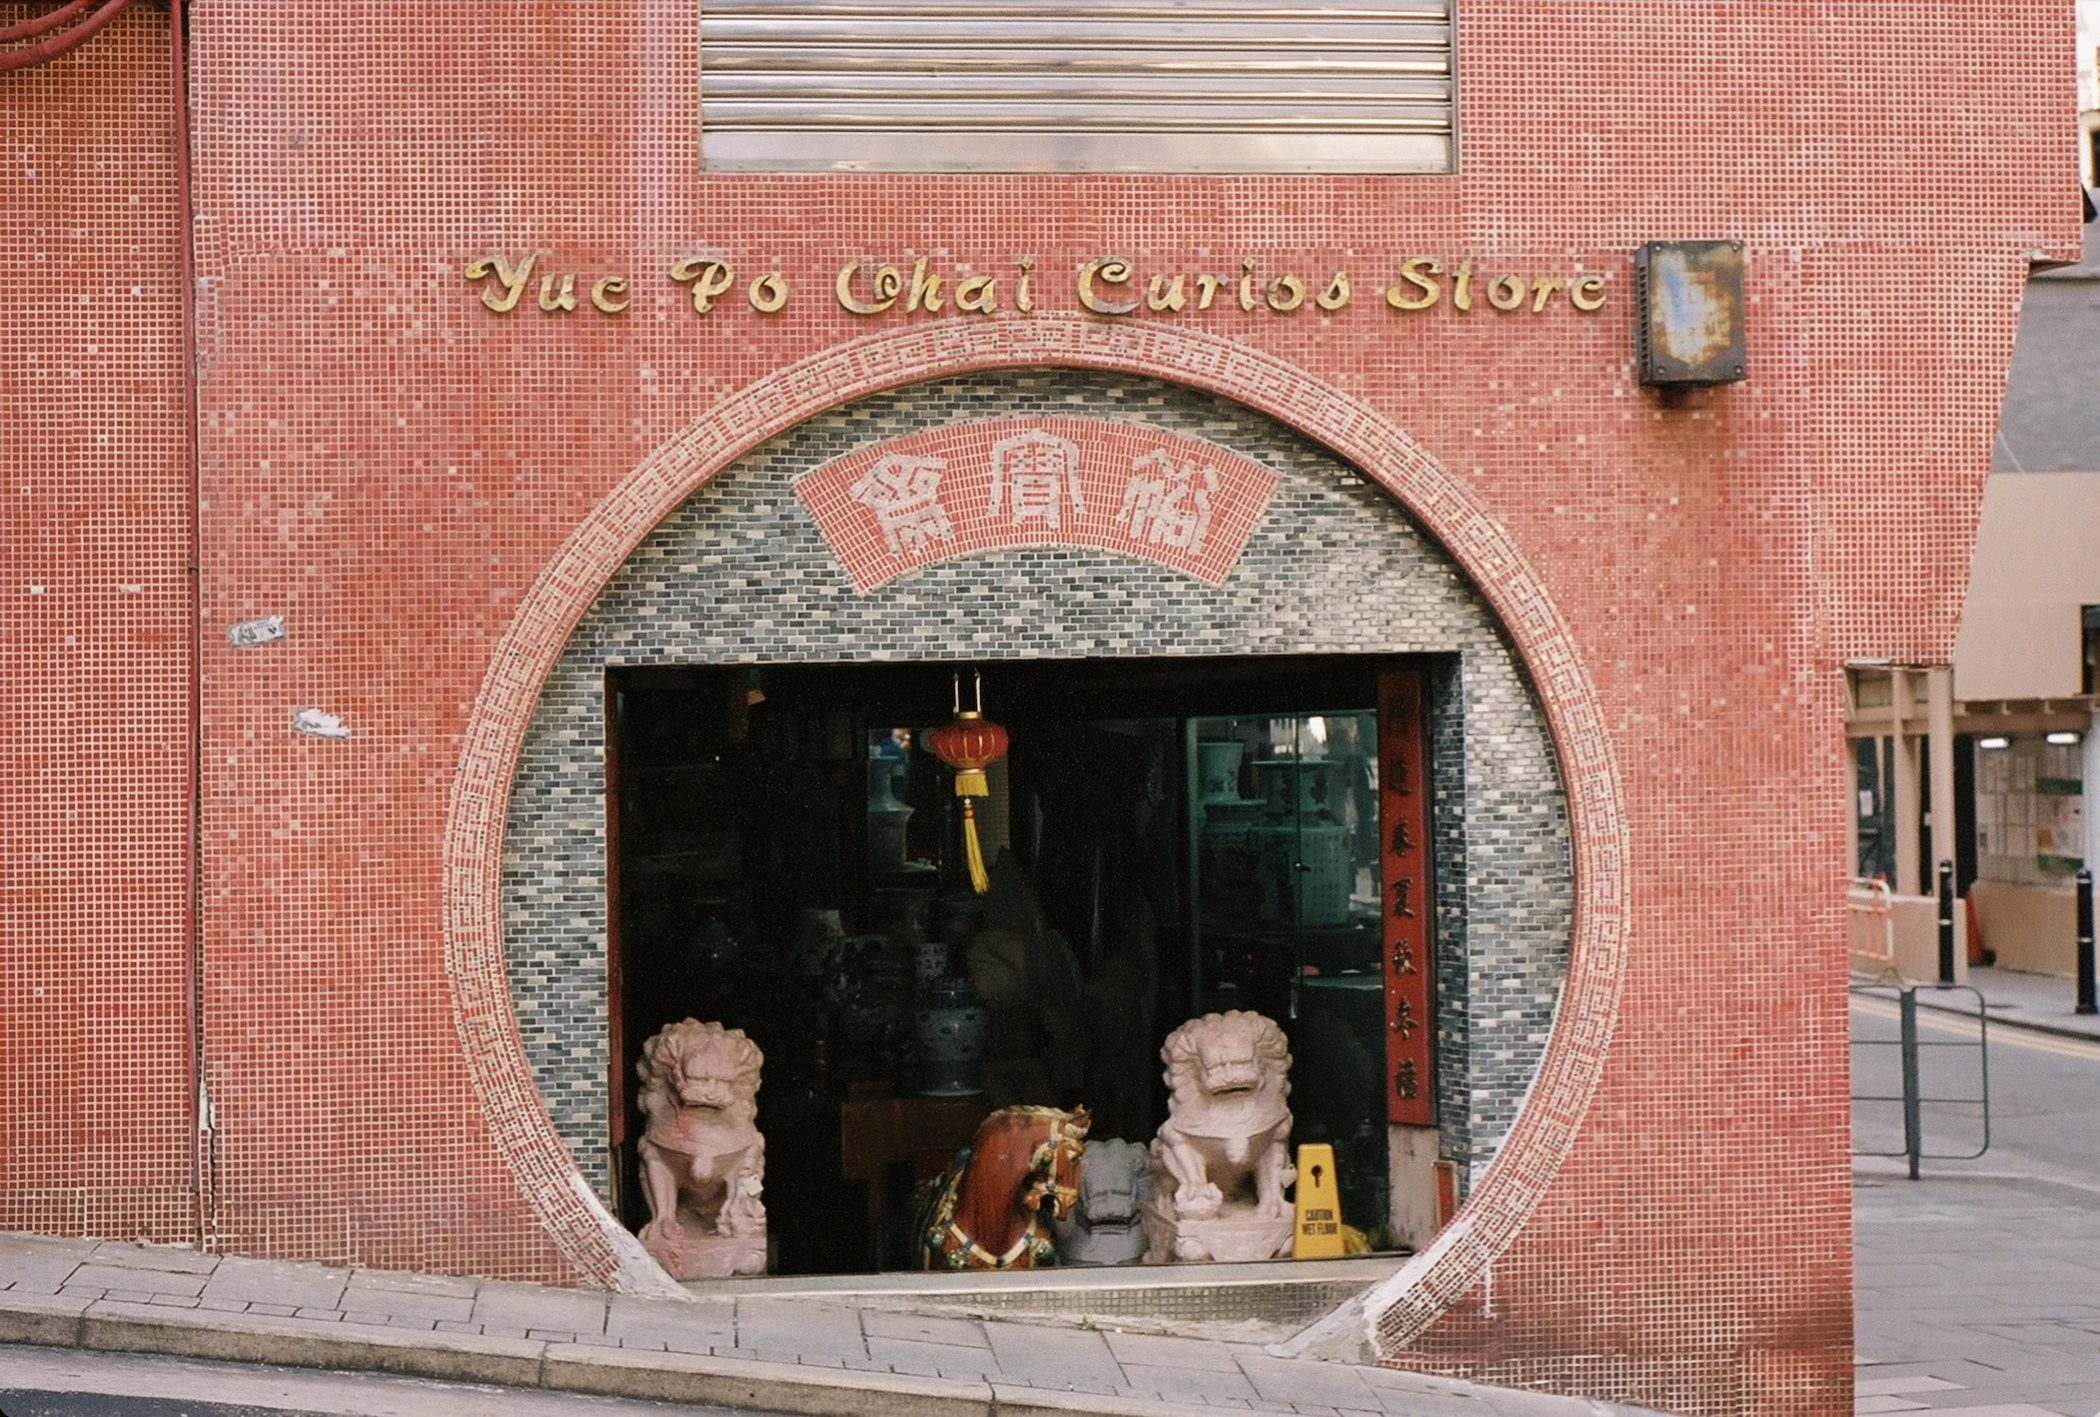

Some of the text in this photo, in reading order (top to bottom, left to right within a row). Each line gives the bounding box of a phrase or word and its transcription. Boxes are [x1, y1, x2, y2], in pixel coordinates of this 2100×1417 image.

[465, 253, 1606, 315] Yue Po Chai Curios Store
[1386, 692, 1419, 1100] 春夏秋冬福
[1302, 1223, 1338, 1235] WET FLOOR
[1305, 1209, 1333, 1221] CAUTION
